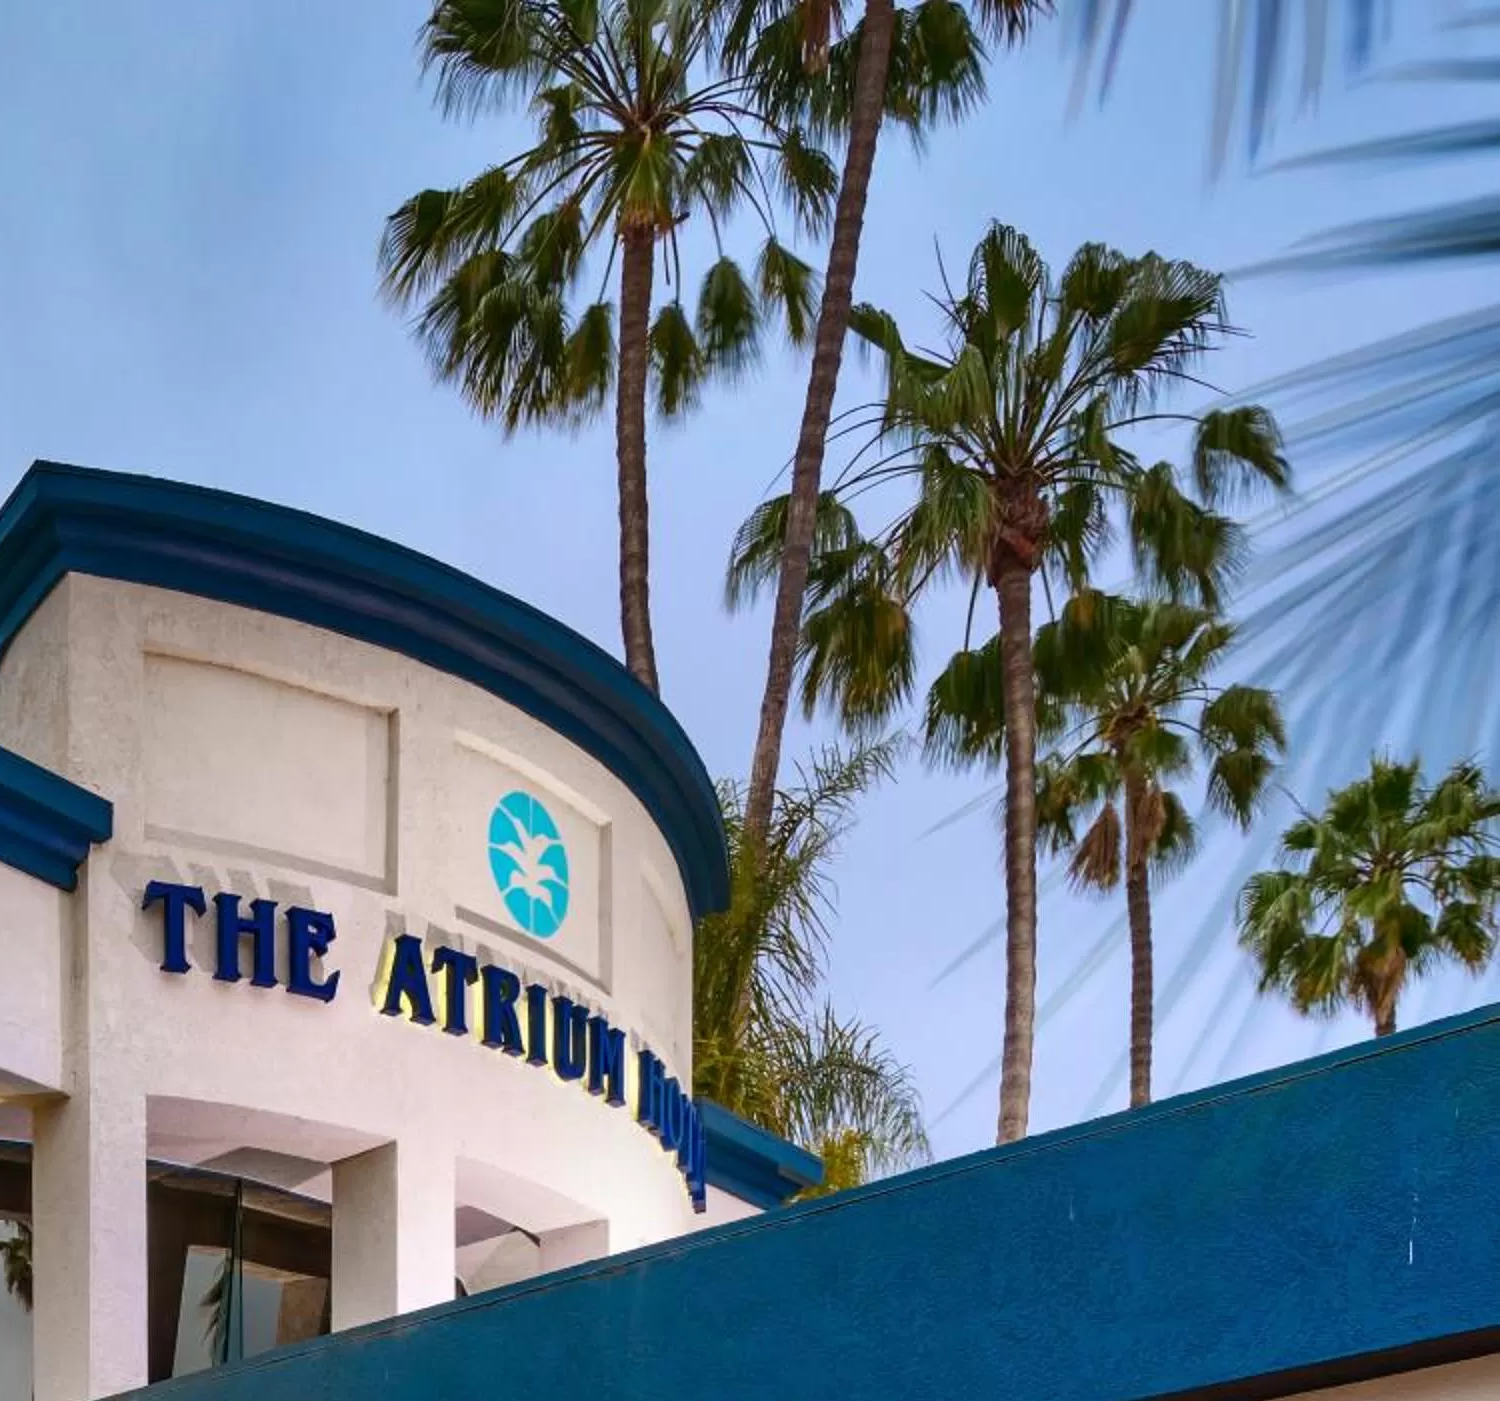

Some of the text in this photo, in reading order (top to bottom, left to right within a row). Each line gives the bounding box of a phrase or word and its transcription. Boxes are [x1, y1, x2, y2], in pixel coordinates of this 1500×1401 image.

[141, 880, 706, 1214] THE ATRIUM HOT
